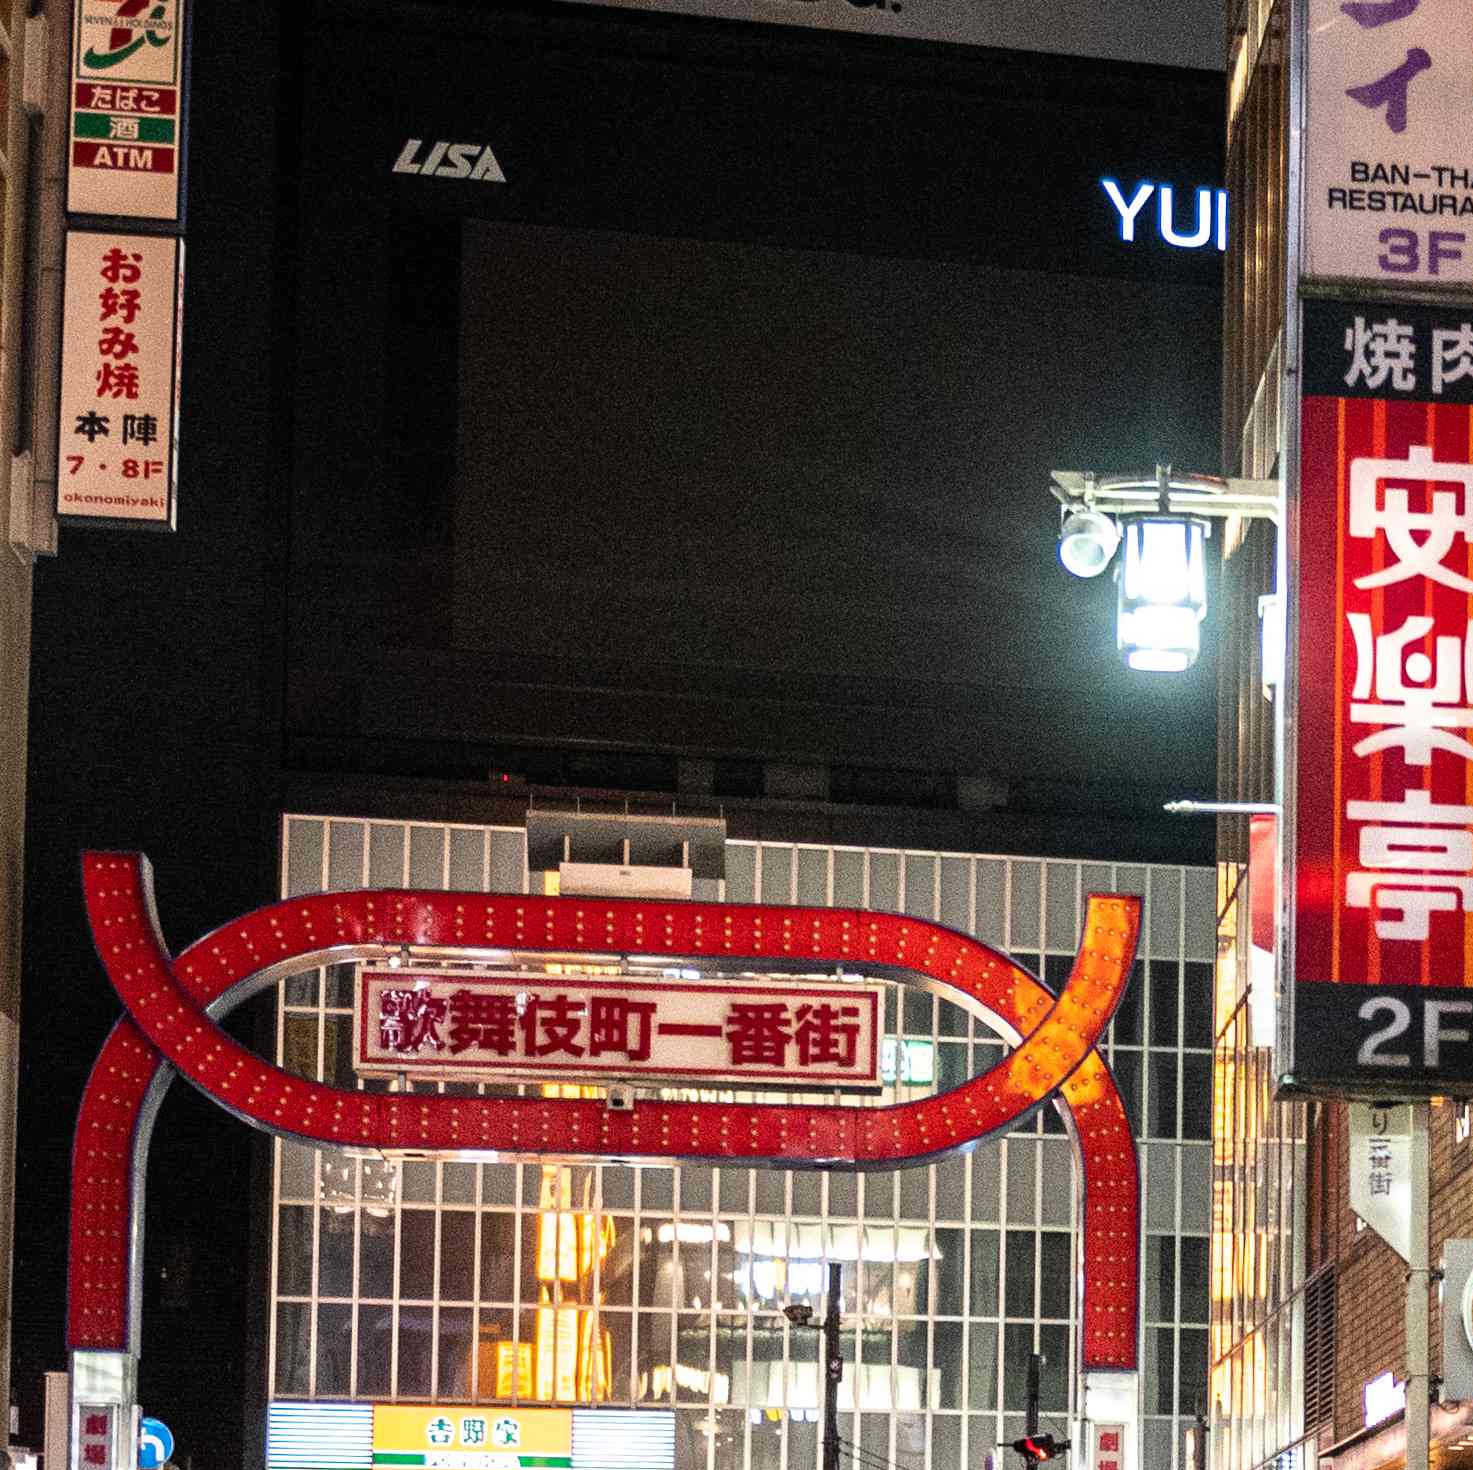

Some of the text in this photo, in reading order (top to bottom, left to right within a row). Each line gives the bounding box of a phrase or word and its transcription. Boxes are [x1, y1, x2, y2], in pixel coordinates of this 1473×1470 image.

[91, 86, 161, 112] たばこ
[109, 117, 140, 139] 酒
[93, 146, 153, 169] ATM
[392, 139, 506, 182] LISA
[1377, 228, 1466, 275] 3F
[96, 247, 143, 400] お好み焼
[74, 411, 159, 447] 本陣
[63, 491, 165, 509] okonomiyaki
[379, 988, 861, 1068] 歌舞伎町一番街
[1357, 996, 1473, 1070] 2F
